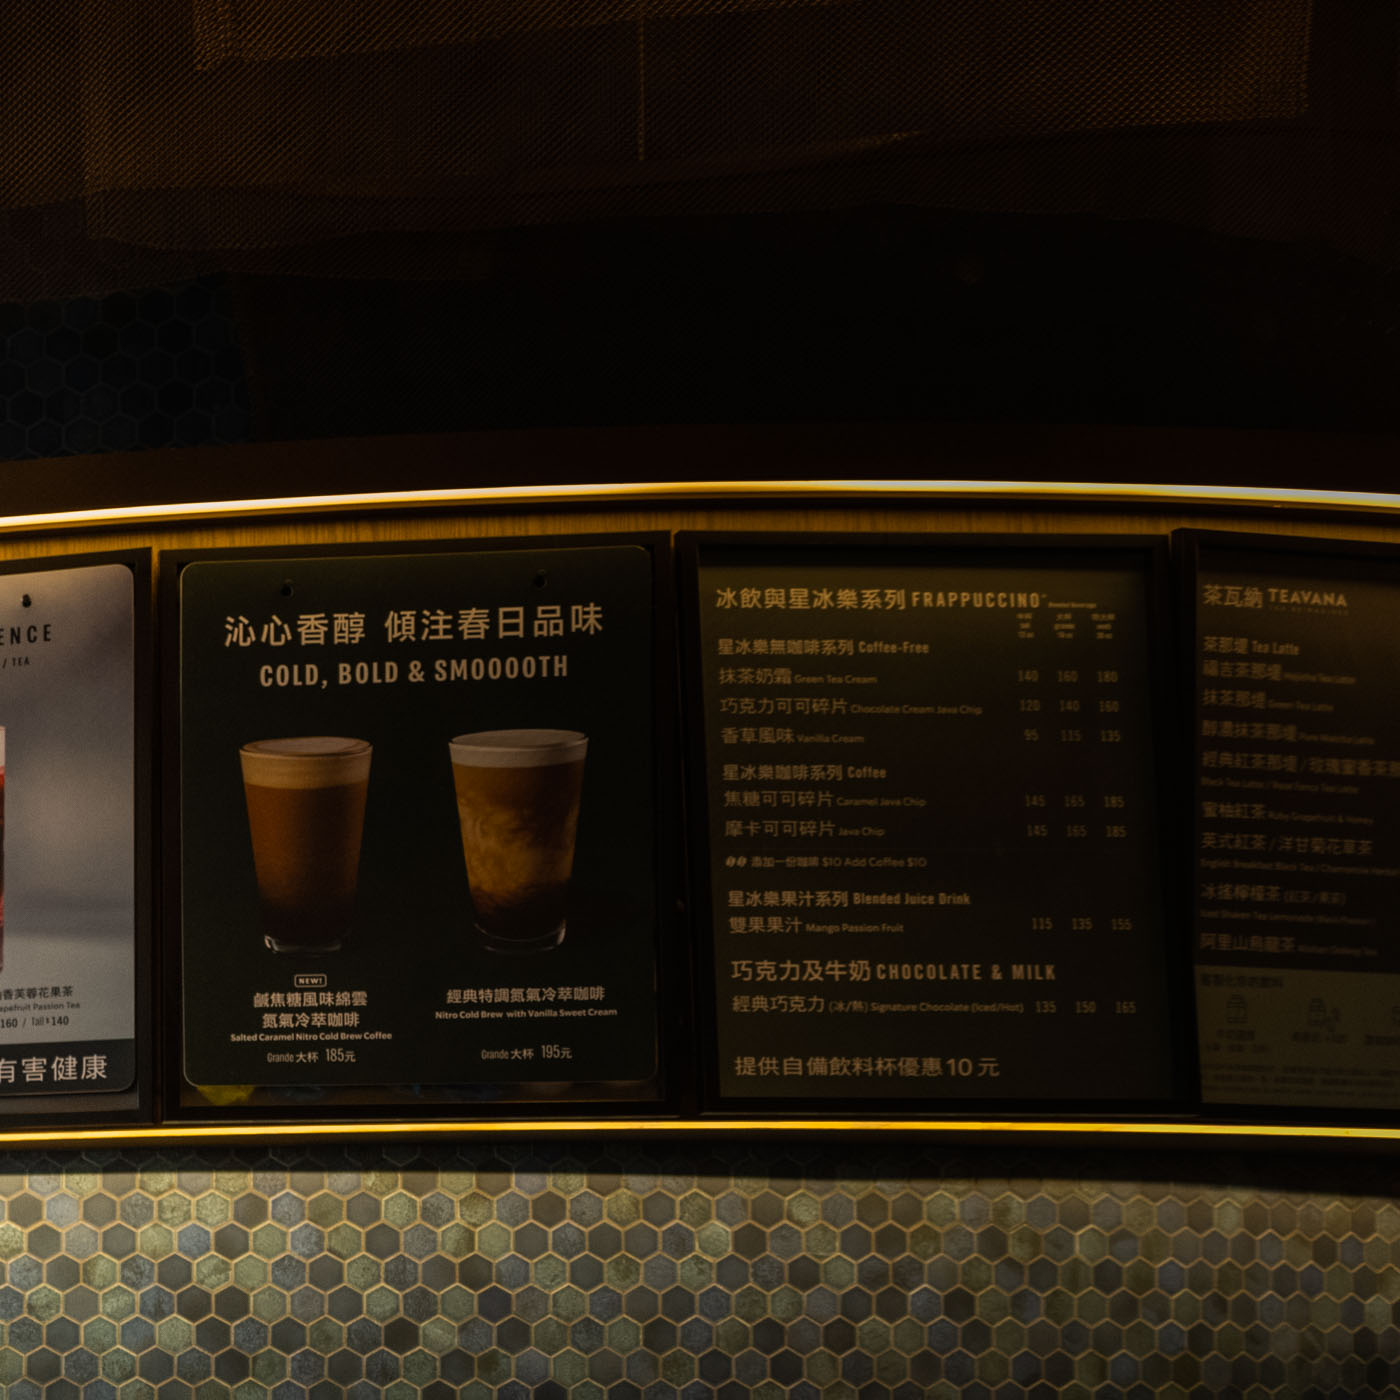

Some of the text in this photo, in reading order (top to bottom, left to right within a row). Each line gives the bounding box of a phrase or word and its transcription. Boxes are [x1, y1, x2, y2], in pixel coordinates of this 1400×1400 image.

[716, 587, 1041, 610] 冰飲與星冰樂系列 FRAPPUCCINO
[1268, 587, 1348, 607] TEAVANA
[224, 602, 604, 647] 沁心香醇 傾注春日品味
[858, 641, 930, 654] Coffee-Free
[11, 656, 31, 667] TEA
[259, 655, 569, 689] COLD, BOLD & SMOOOOTH
[720, 697, 848, 714] 巧克力可可碎片
[721, 726, 794, 744] 香草風味
[847, 766, 887, 779] Coffee
[844, 856, 867, 868] Add
[728, 890, 971, 908] 星冰樂果汁系列 Blended Juice Drink
[805, 923, 840, 934] Mango
[841, 923, 880, 933] Passion
[881, 922, 904, 933] Fruit
[1071, 917, 1093, 930] 135
[730, 960, 1057, 982] 巧克力及牛奶 CHOCOLATE & MILK
[298, 977, 323, 985] NEW!
[33, 1002, 65, 1010] Passion
[66, 1001, 81, 1009] Tea
[731, 995, 825, 1014] 經典巧克力
[262, 1011, 360, 1029] 氮氣冷萃咖啡
[435, 1008, 618, 1020] Nitro Cold Brew with Vanilla Sweet Cream
[230, 1031, 392, 1042] Salted Caramel Nitro Cold Brew Coffee
[296, 1051, 319, 1063] 大杯
[511, 1048, 534, 1060] 大杯
